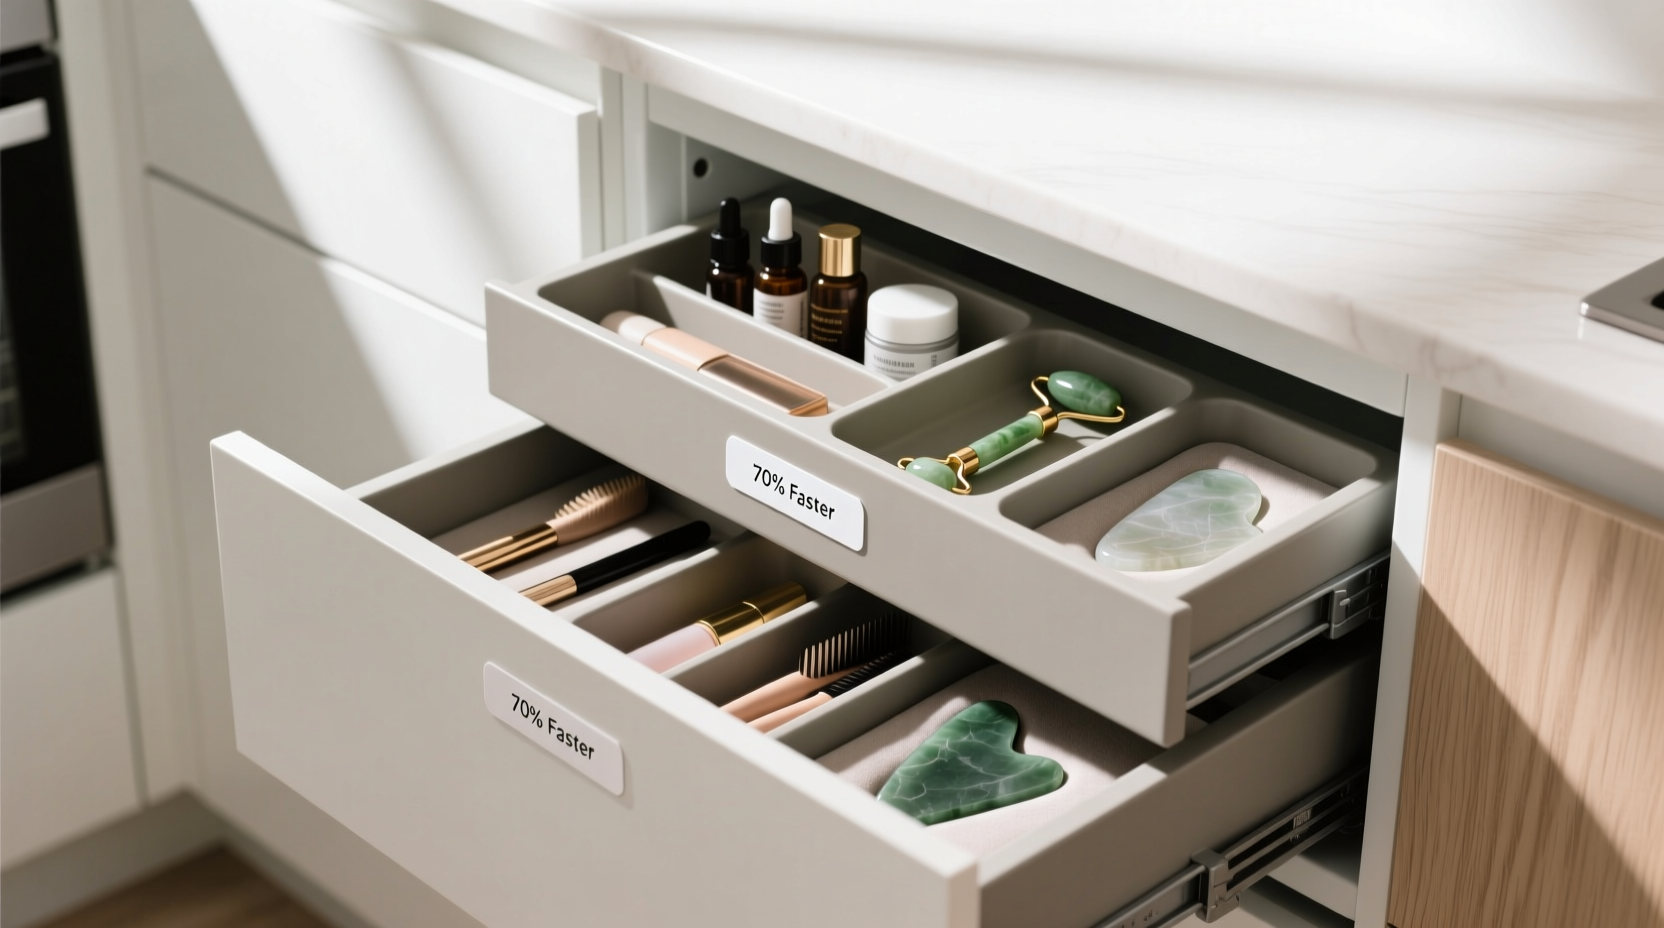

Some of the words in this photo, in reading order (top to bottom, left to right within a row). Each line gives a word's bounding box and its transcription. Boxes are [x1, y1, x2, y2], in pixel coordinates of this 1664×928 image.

[753, 463, 785, 495] 70%
[789, 483, 835, 520] Faster
[511, 693, 543, 728] 70%
[548, 717, 595, 760] Faster
